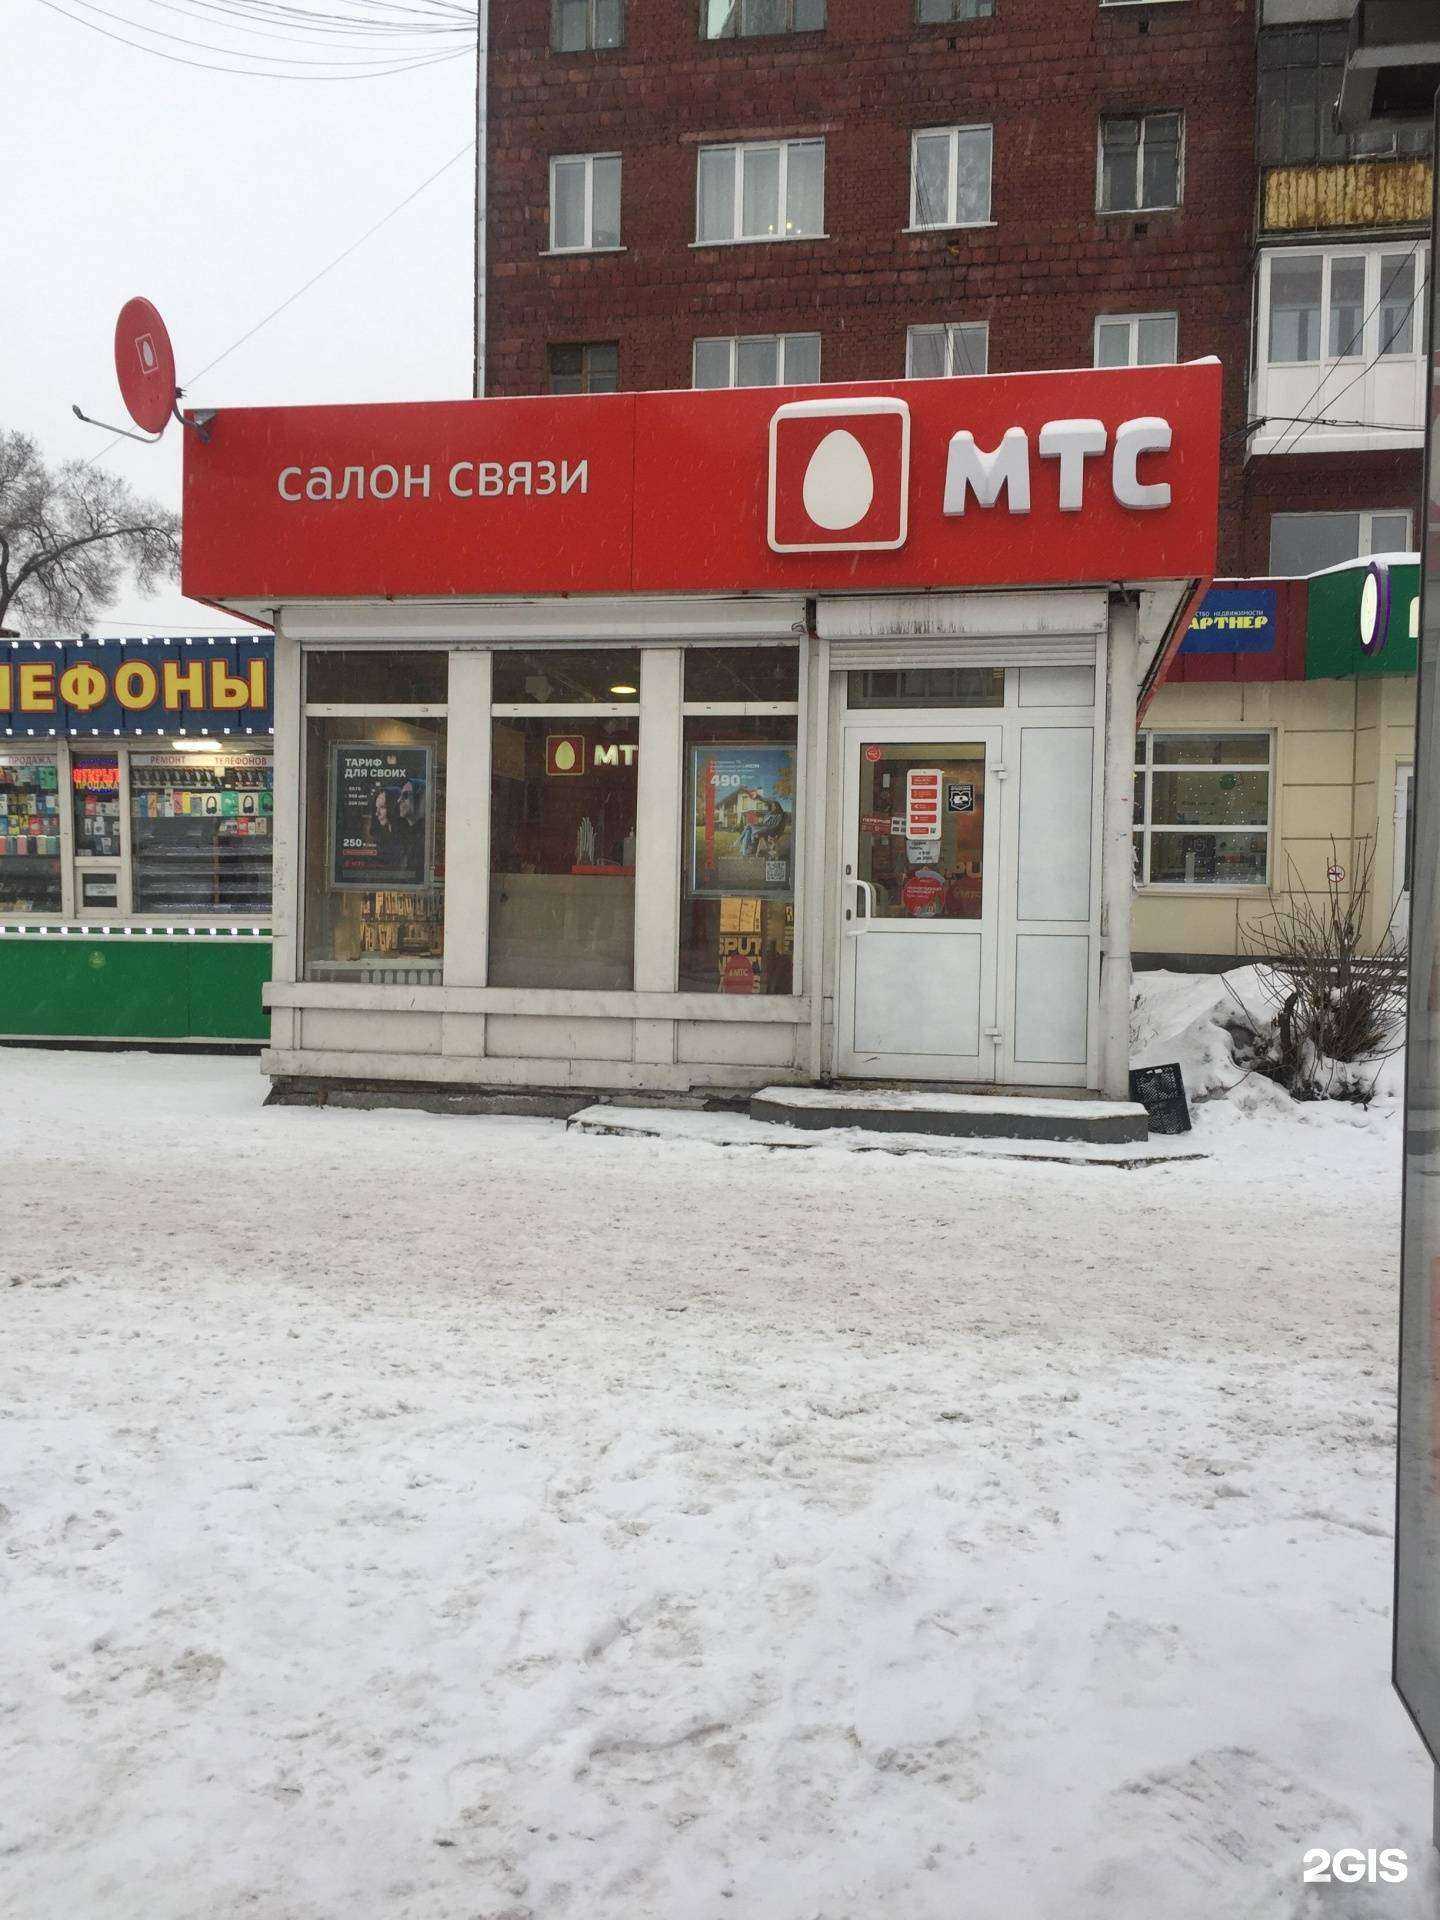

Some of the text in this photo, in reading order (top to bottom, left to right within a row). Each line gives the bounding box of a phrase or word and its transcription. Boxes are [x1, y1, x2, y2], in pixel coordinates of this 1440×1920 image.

[943, 416, 1172, 516] МТС
[1188, 616, 1268, 629] АРТНЕР
[150, 755, 267, 766] РЕМОНТ ТЕЛЕФОНОВ
[594, 744, 639, 766] МТ
[344, 758, 383, 767] ТАРИФ
[344, 768, 407, 778] ДЛЯ СВОИХ
[710, 774, 740, 786] 490
[343, 839, 362, 847] 250
